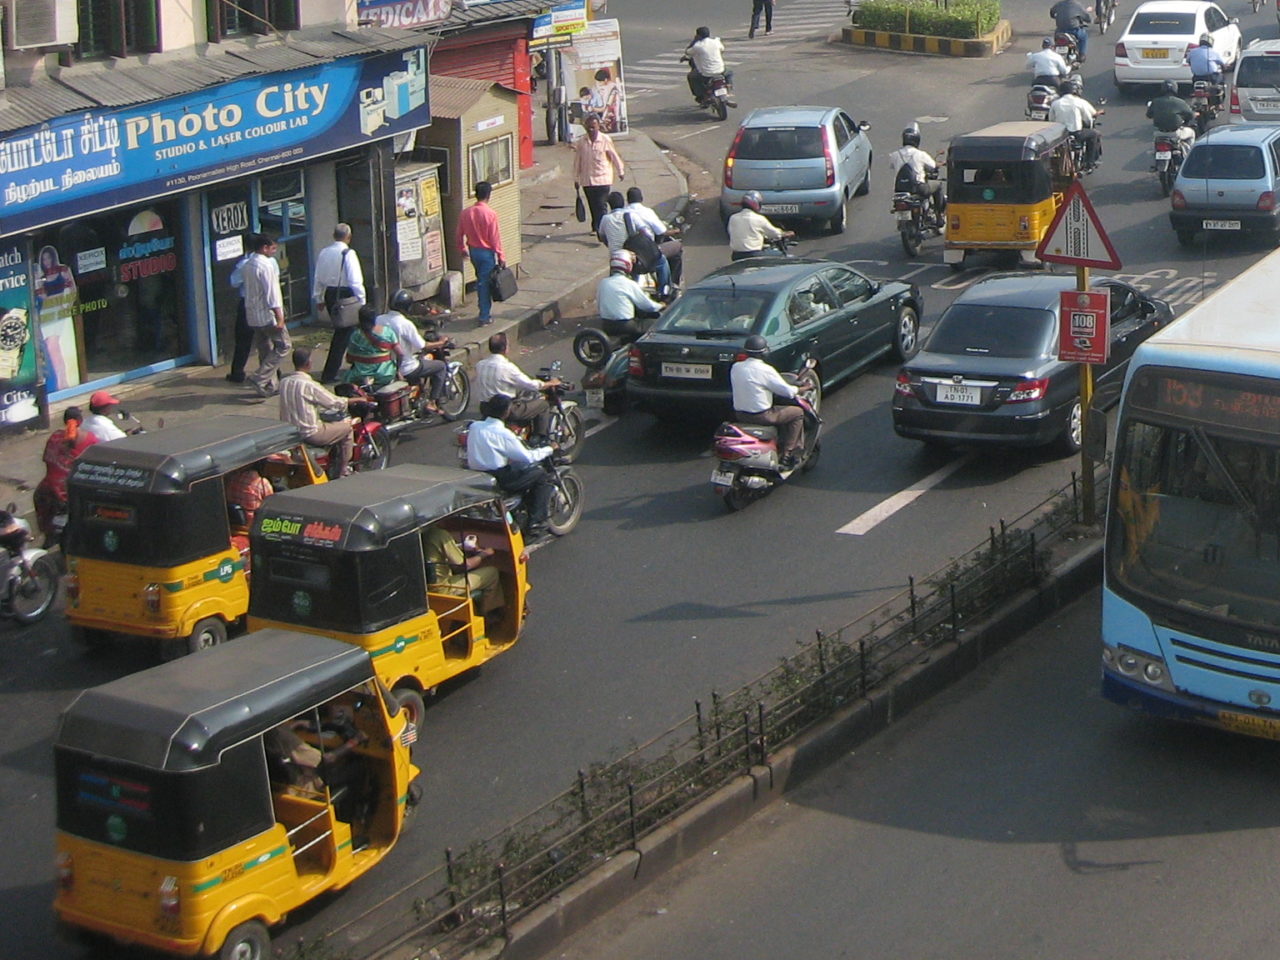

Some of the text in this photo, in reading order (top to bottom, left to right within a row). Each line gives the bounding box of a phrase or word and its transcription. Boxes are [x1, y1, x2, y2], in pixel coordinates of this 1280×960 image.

[125, 82, 329, 150] Photo City
[155, 115, 308, 161] STUDIO & LASER COLOUR LAB
[61, 159, 121, 192] நிலையம்
[214, 204, 247, 232] XEROX
[120, 252, 177, 282] STUDIO
[80, 298, 108, 314] PHOTO
[1073, 314, 1093, 328] 108
[219, 564, 233, 576] LPG
[1246, 633, 1280, 649] TATA
